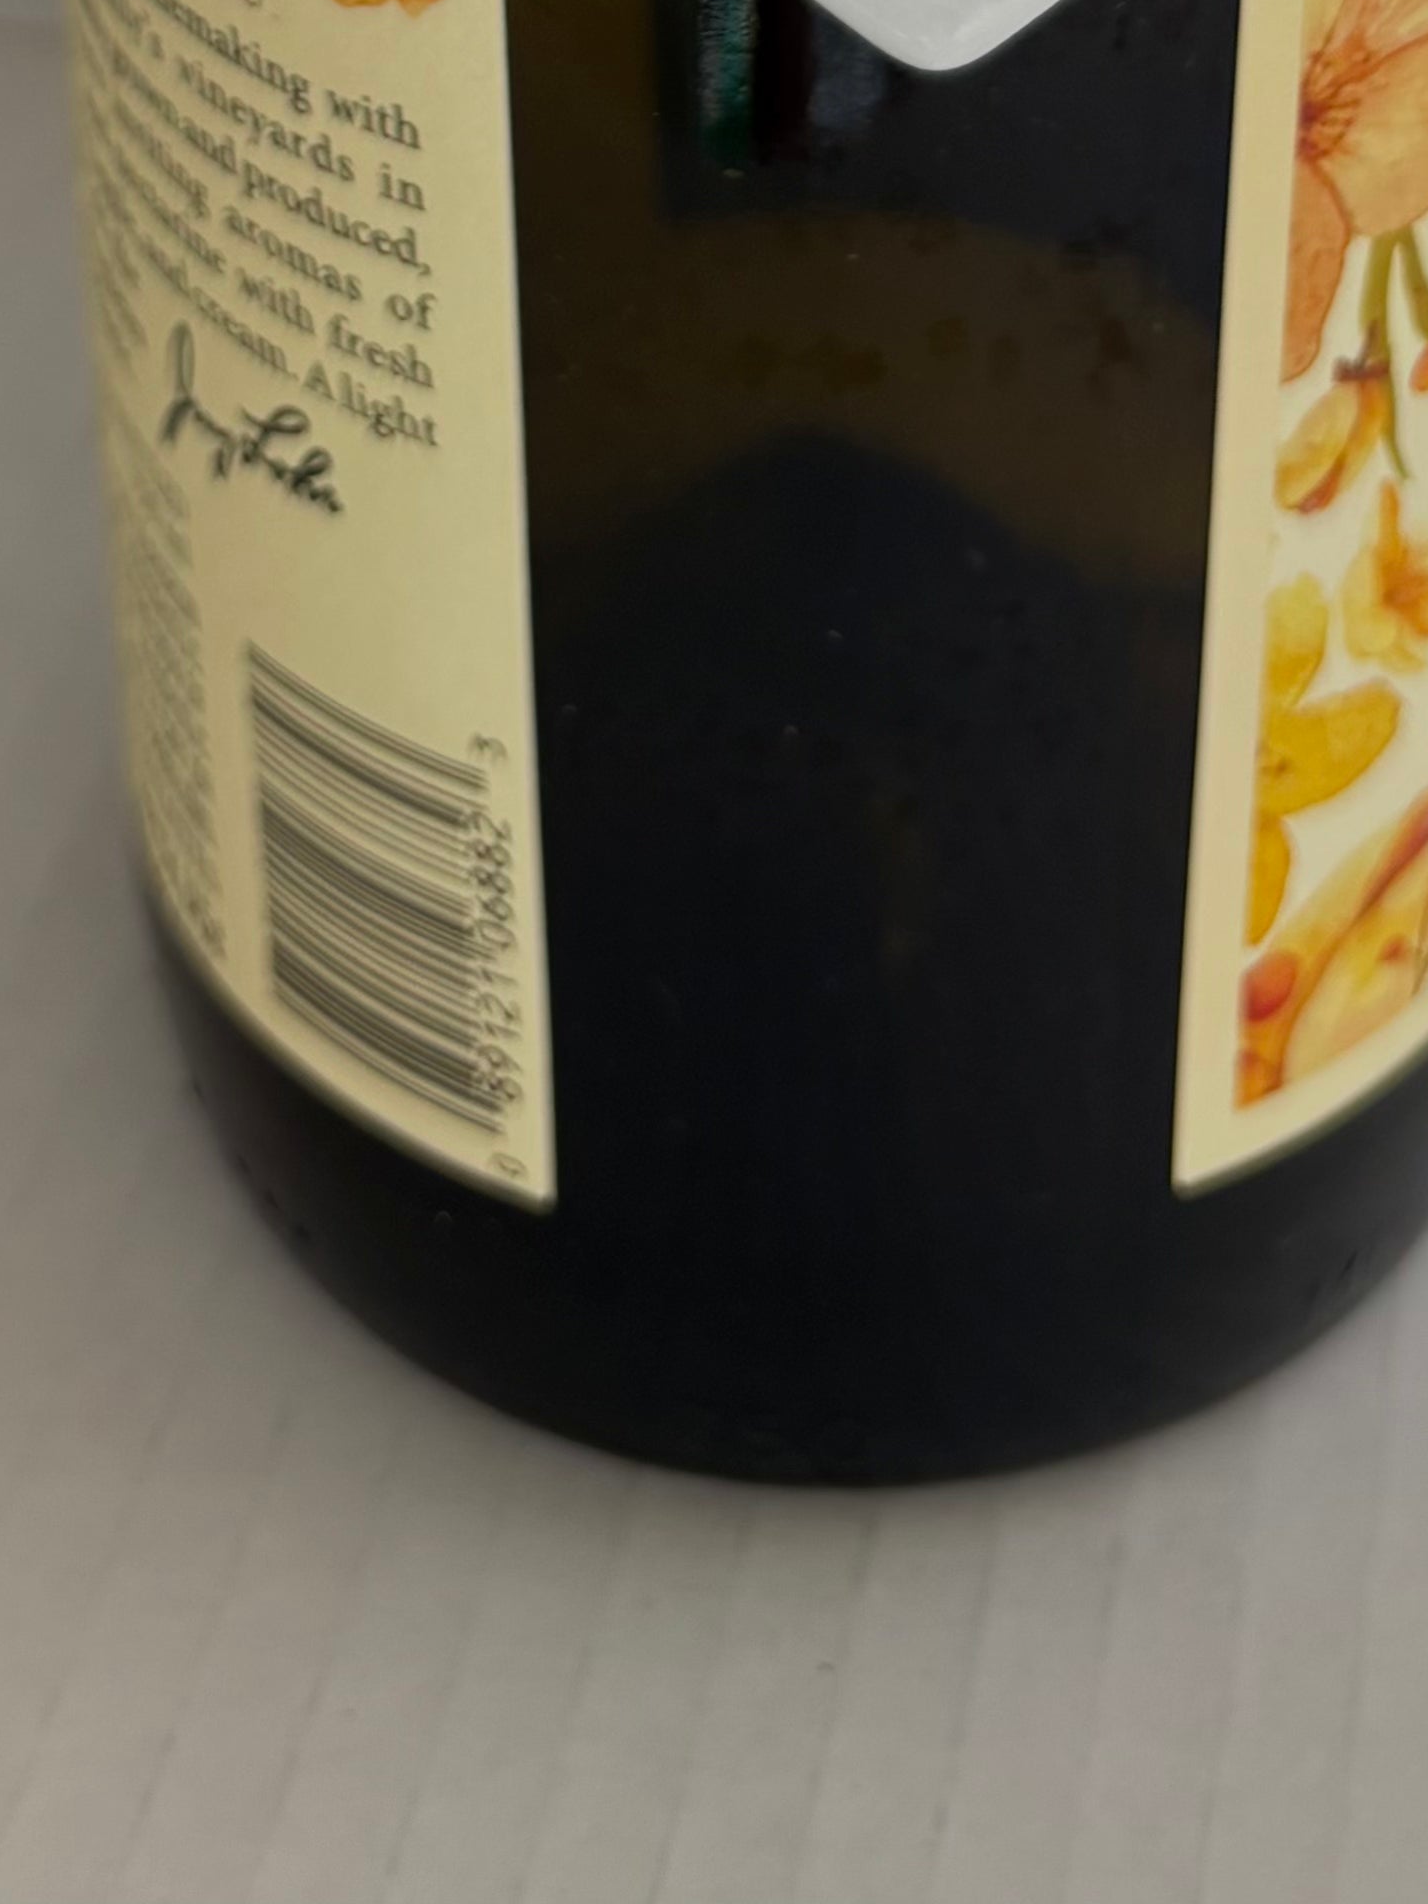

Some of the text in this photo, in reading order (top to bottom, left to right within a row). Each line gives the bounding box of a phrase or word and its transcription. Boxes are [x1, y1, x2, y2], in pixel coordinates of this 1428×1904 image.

[178, 58, 356, 182] vineyards
[378, 163, 426, 212] in
[325, 89, 421, 150] with
[181, 110, 238, 178] and
[243, 159, 433, 278] produced,
[226, 204, 438, 332] aromas of
[238, 267, 317, 336] with
[329, 313, 435, 390] fresh
[302, 360, 336, 401] A
[338, 370, 440, 449] light
